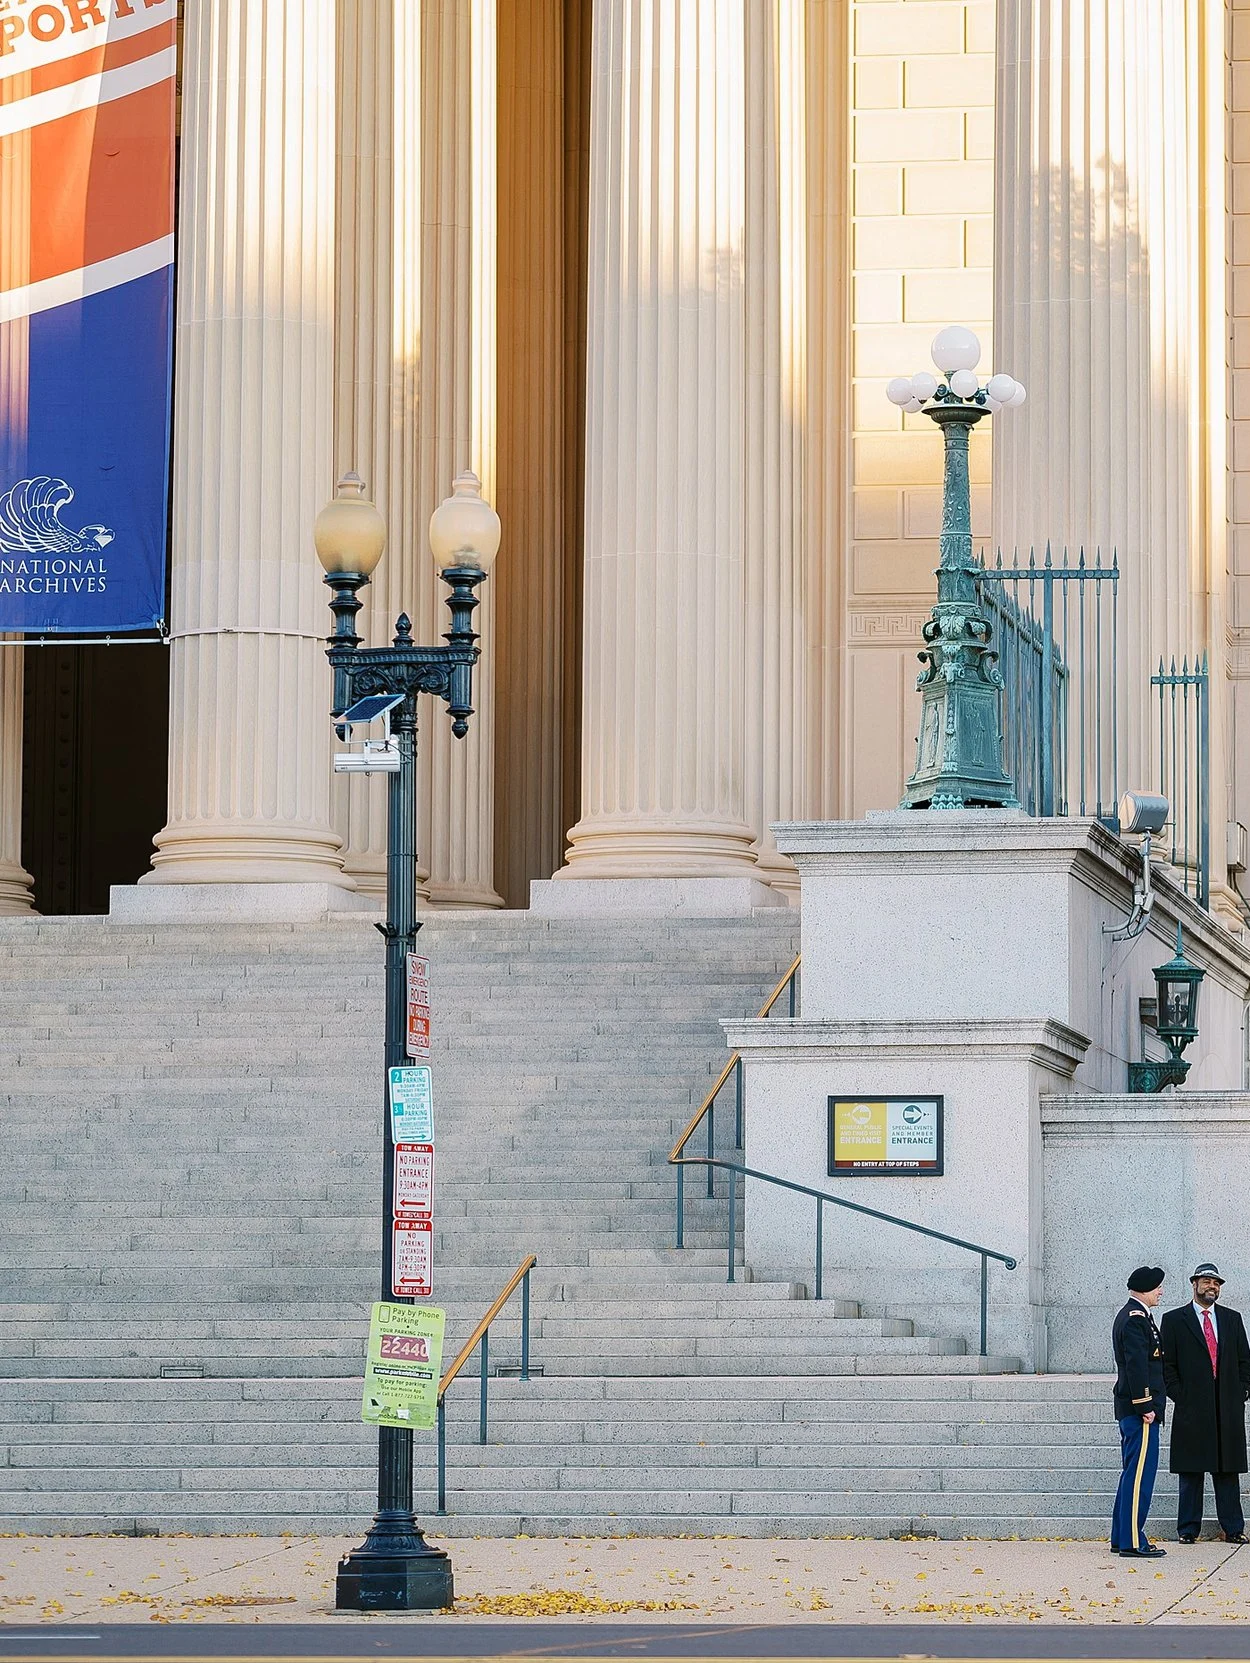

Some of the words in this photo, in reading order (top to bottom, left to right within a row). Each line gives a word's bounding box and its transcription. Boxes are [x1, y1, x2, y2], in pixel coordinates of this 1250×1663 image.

[1, 559, 107, 574] NATIONAL
[0, 577, 106, 593] ARCHIVES
[411, 988, 428, 1004] ROUTE
[394, 1072, 400, 1082] 2
[400, 1156, 407, 1165] NO
[409, 1156, 429, 1166] PARKING
[400, 1168, 428, 1178] ENTRANCE
[393, 1308, 406, 1316] Pay
[418, 1311, 440, 1319] Phone
[392, 1316, 419, 1326] Parking
